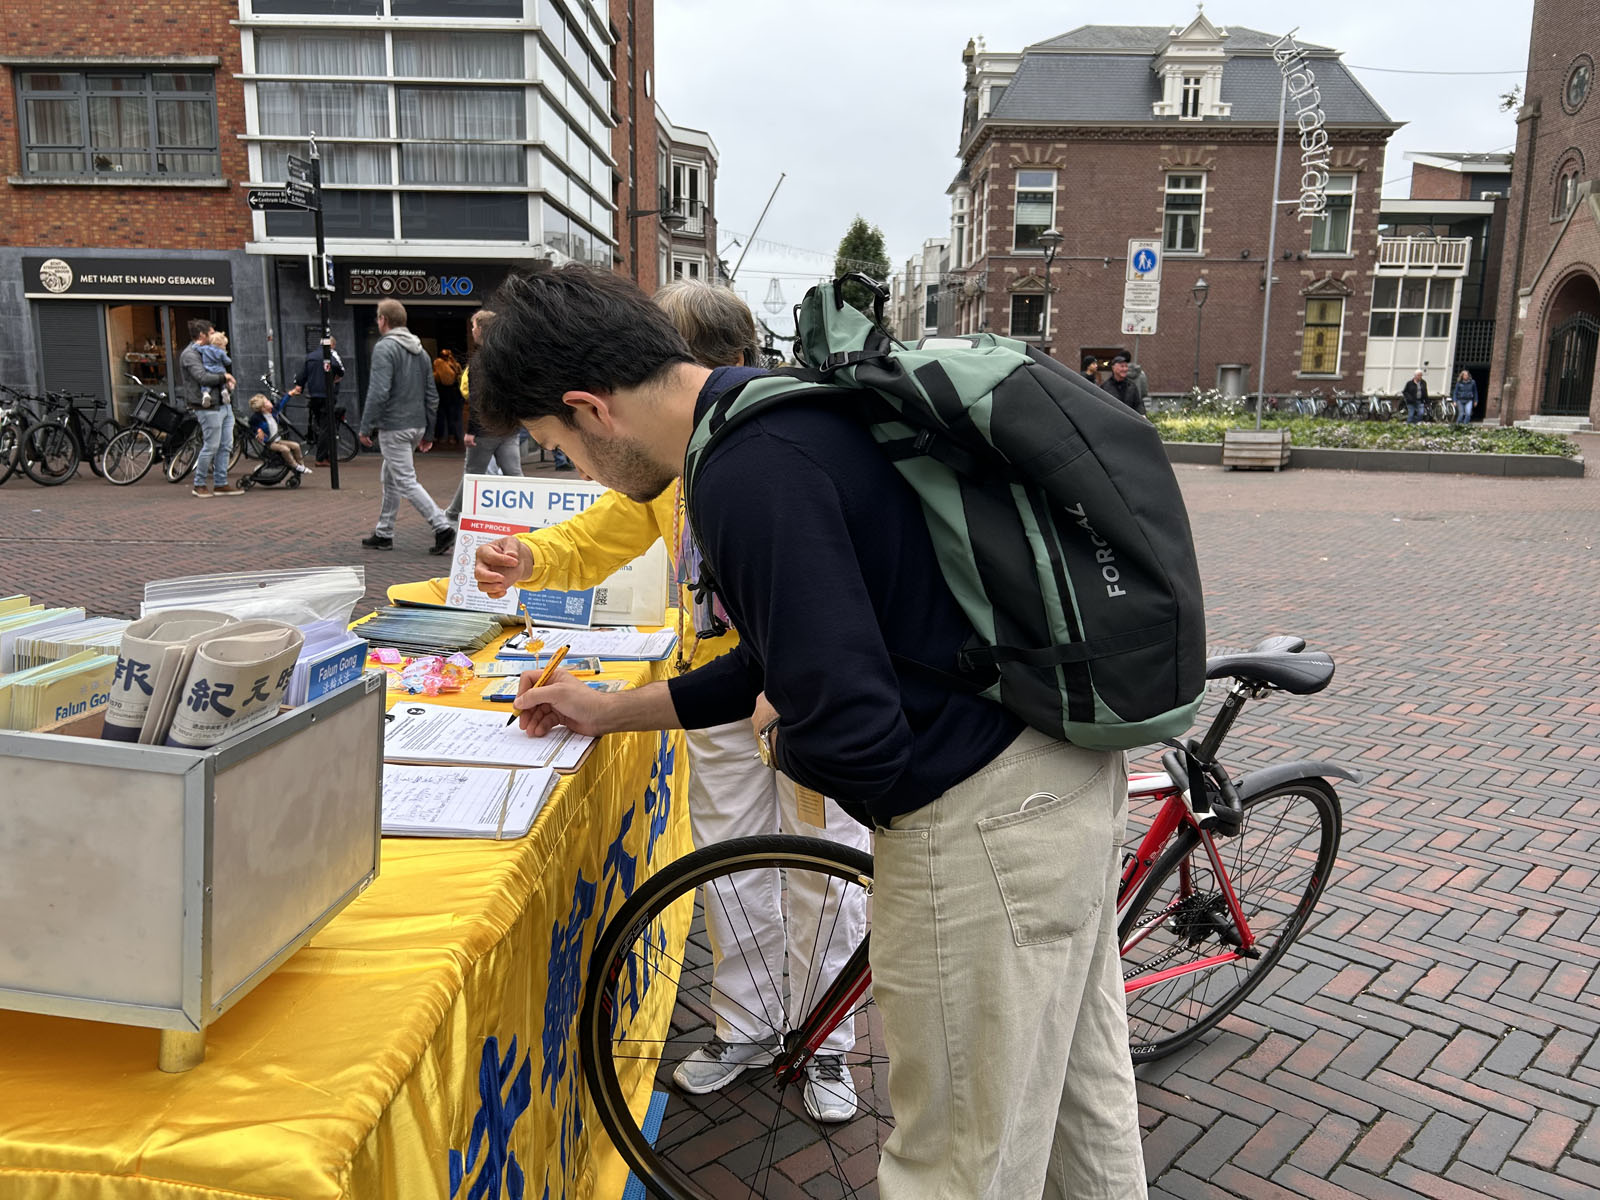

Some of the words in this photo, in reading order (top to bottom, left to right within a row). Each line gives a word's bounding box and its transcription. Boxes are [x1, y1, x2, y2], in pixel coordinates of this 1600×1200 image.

[80, 274, 98, 283] MET
[100, 275, 123, 283] HART
[125, 276, 137, 284] EN
[140, 276, 166, 284] HAND
[168, 276, 215, 285] GEBAKKEN
[350, 276, 473, 296] BROOD&KO
[480, 489, 534, 510] SIGN
[548, 492, 602, 512] PETI
[485, 523, 511, 532] PROCES
[318, 664, 338, 682] Falun
[339, 654, 358, 672] Gong
[56, 702, 87, 721] Falun
